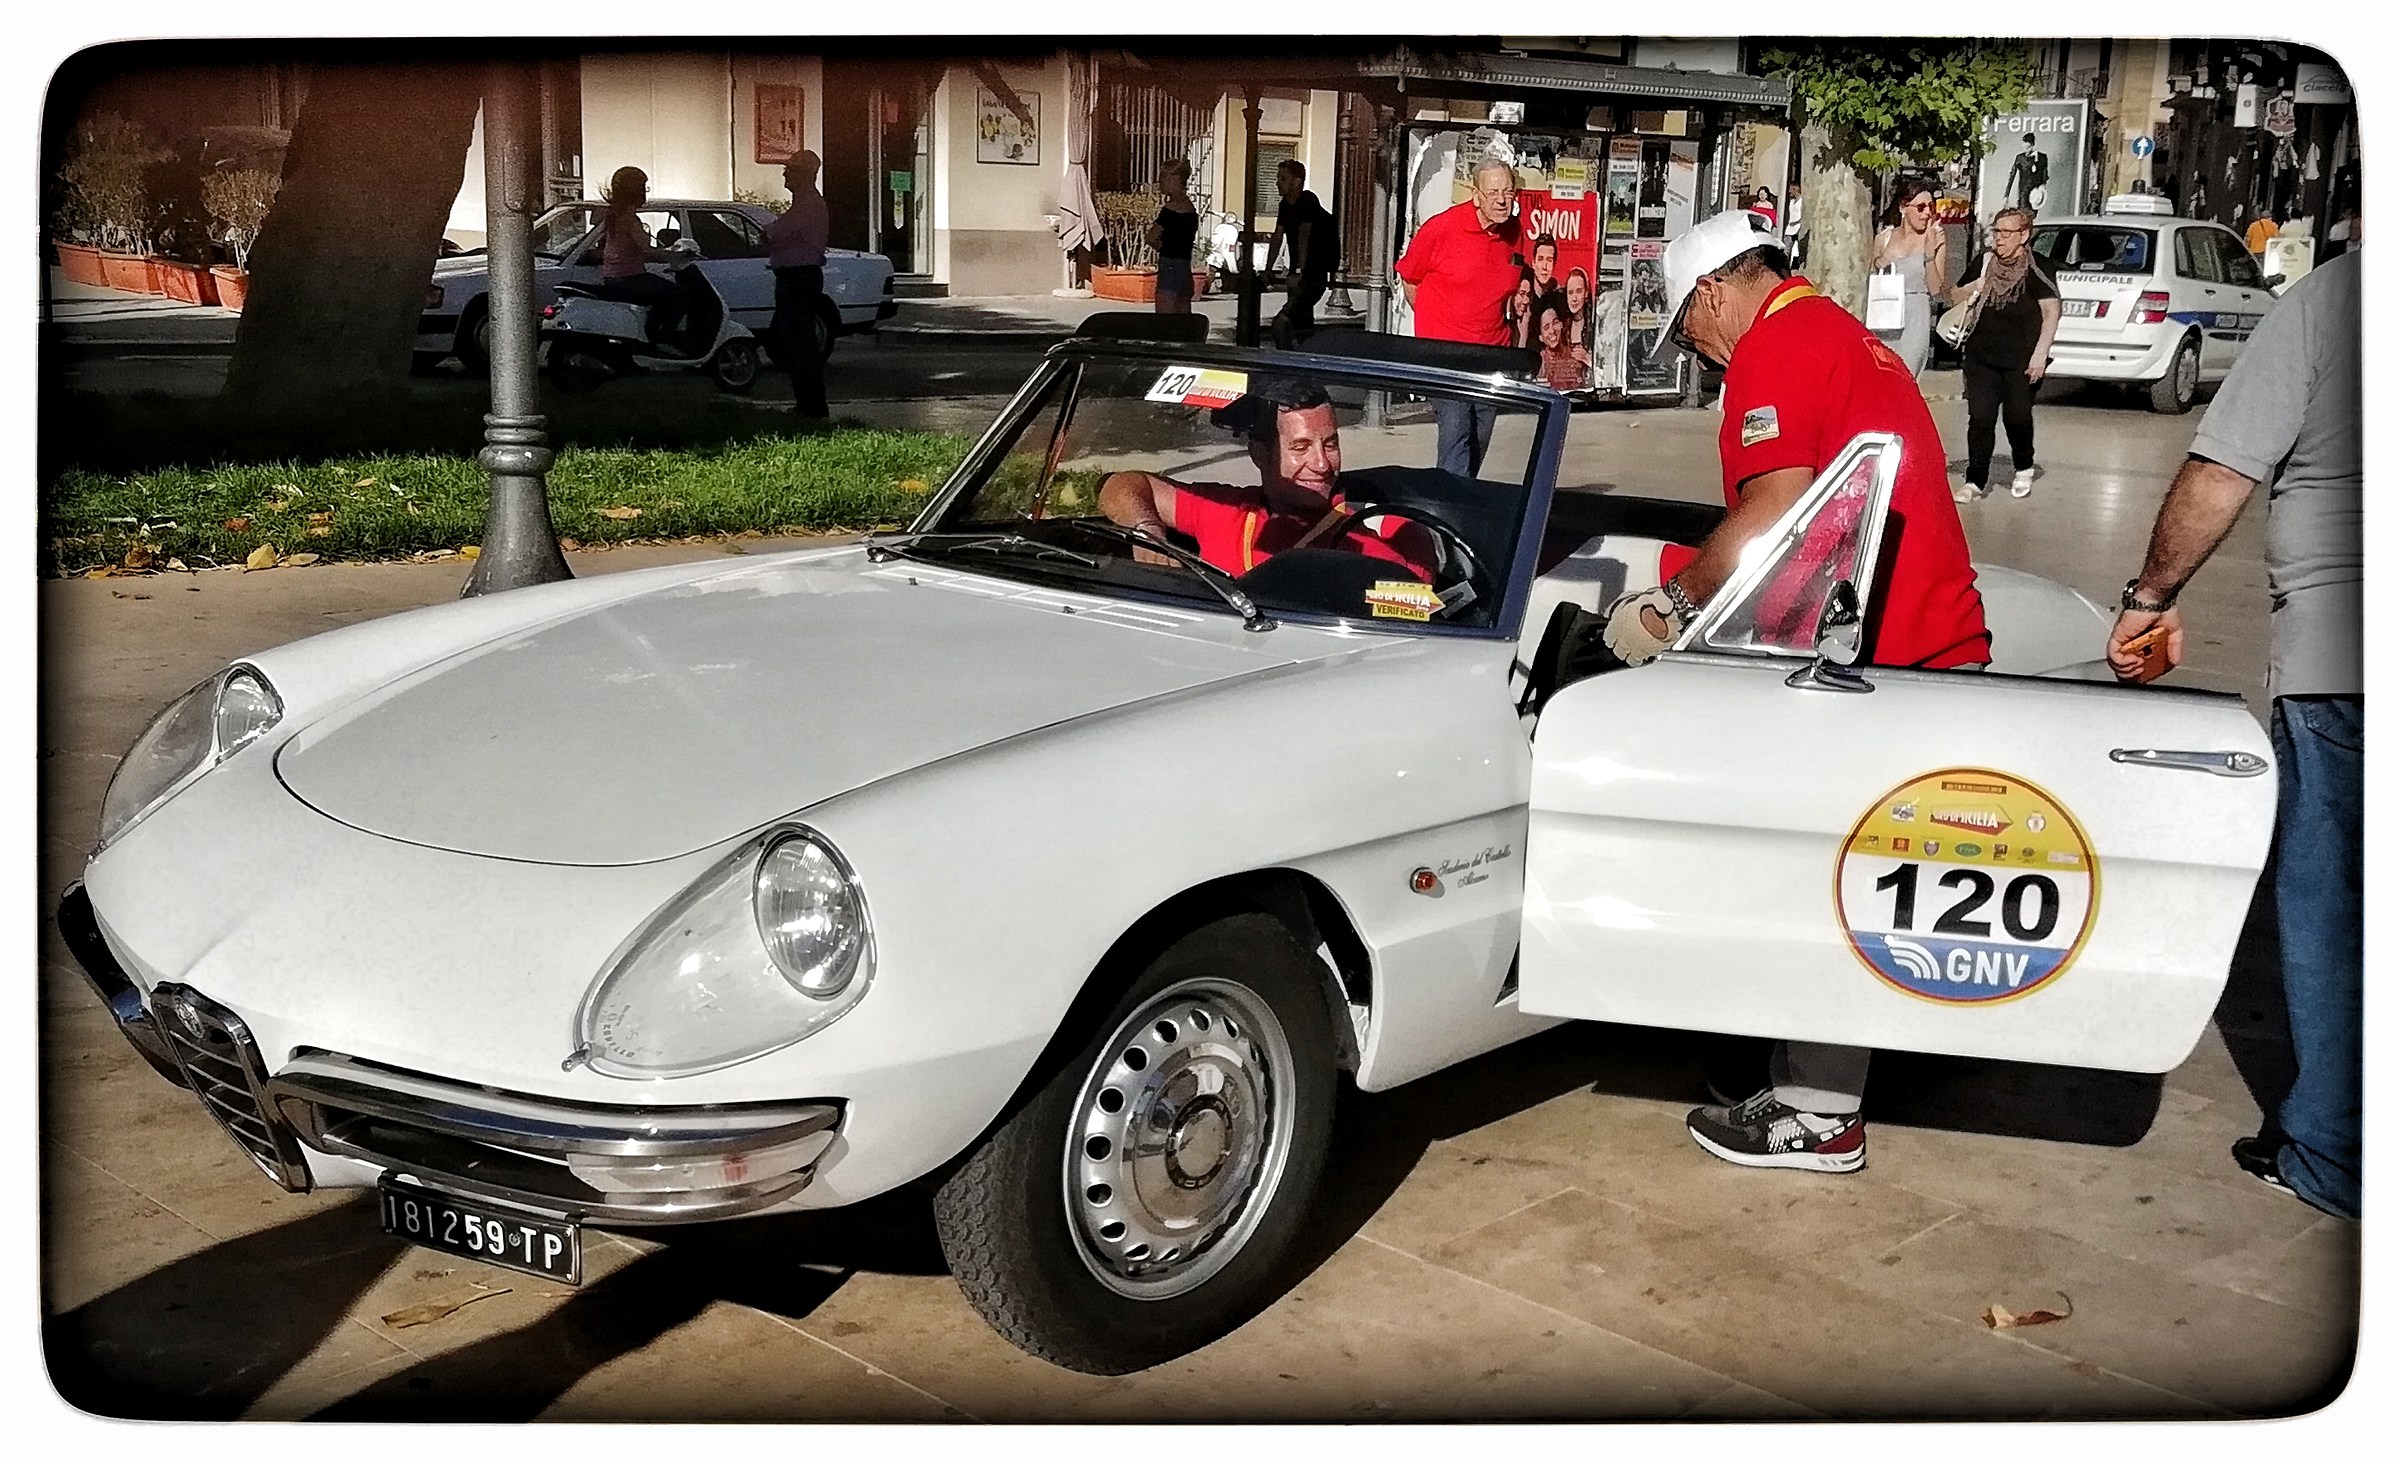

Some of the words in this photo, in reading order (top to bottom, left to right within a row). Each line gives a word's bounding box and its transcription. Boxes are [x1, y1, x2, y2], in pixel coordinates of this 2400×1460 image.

[1993, 112, 2075, 132] Ferrara
[1527, 208, 1581, 241] SIMON
[1156, 372, 1197, 396] 120
[1376, 603, 1426, 619] VERIFICATO
[1876, 863, 2060, 942] 120
[1946, 947, 2030, 988] GNV
[389, 1195, 505, 1256] 181259
[519, 1226, 563, 1270] TP
